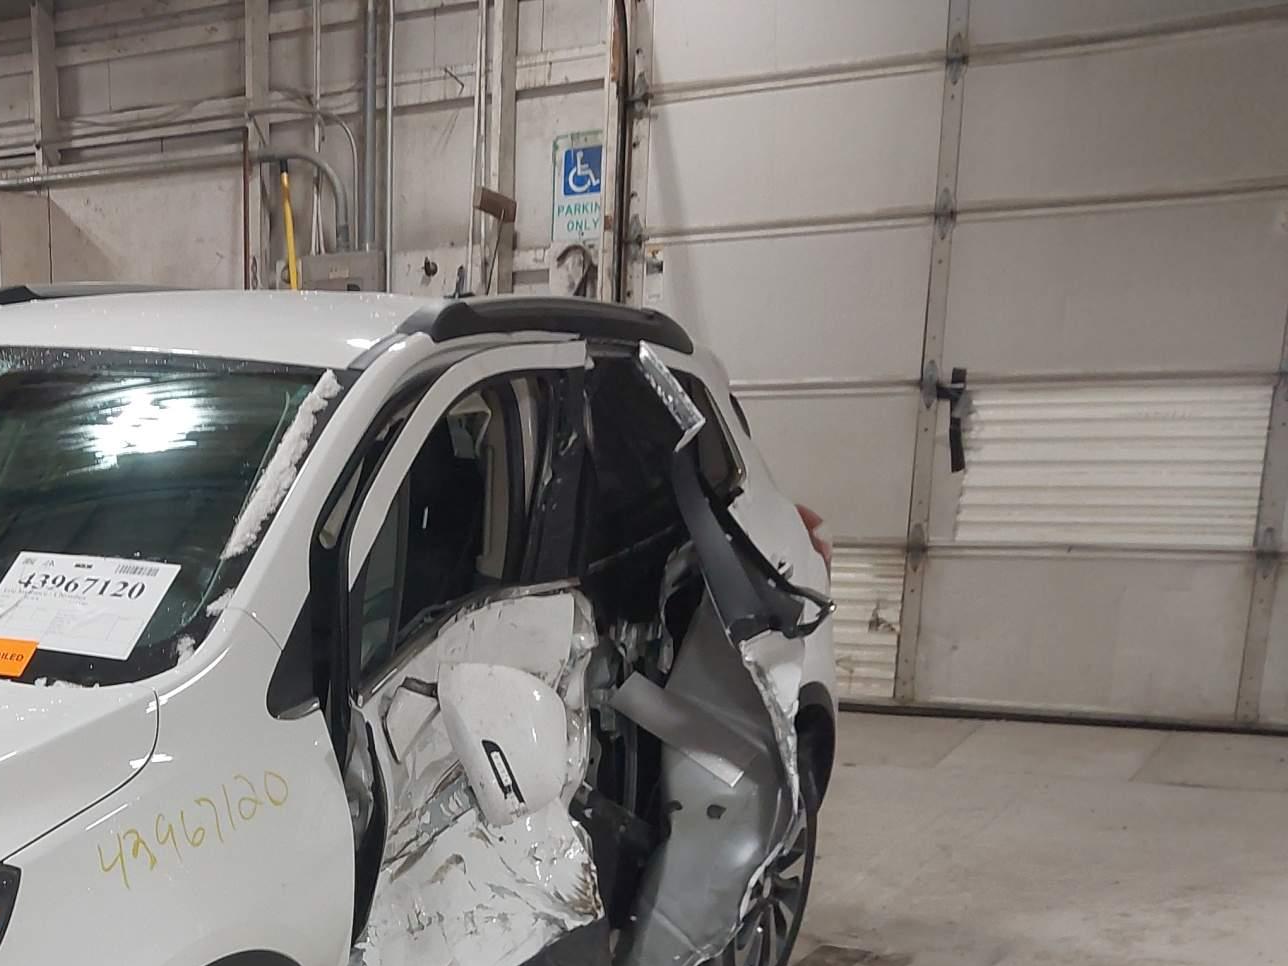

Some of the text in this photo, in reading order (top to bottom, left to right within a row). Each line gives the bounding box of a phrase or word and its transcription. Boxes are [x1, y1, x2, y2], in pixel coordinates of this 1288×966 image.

[567, 219, 601, 232] ONLY
[18, 572, 146, 600] 43967120
[97, 771, 289, 890] 43967120
